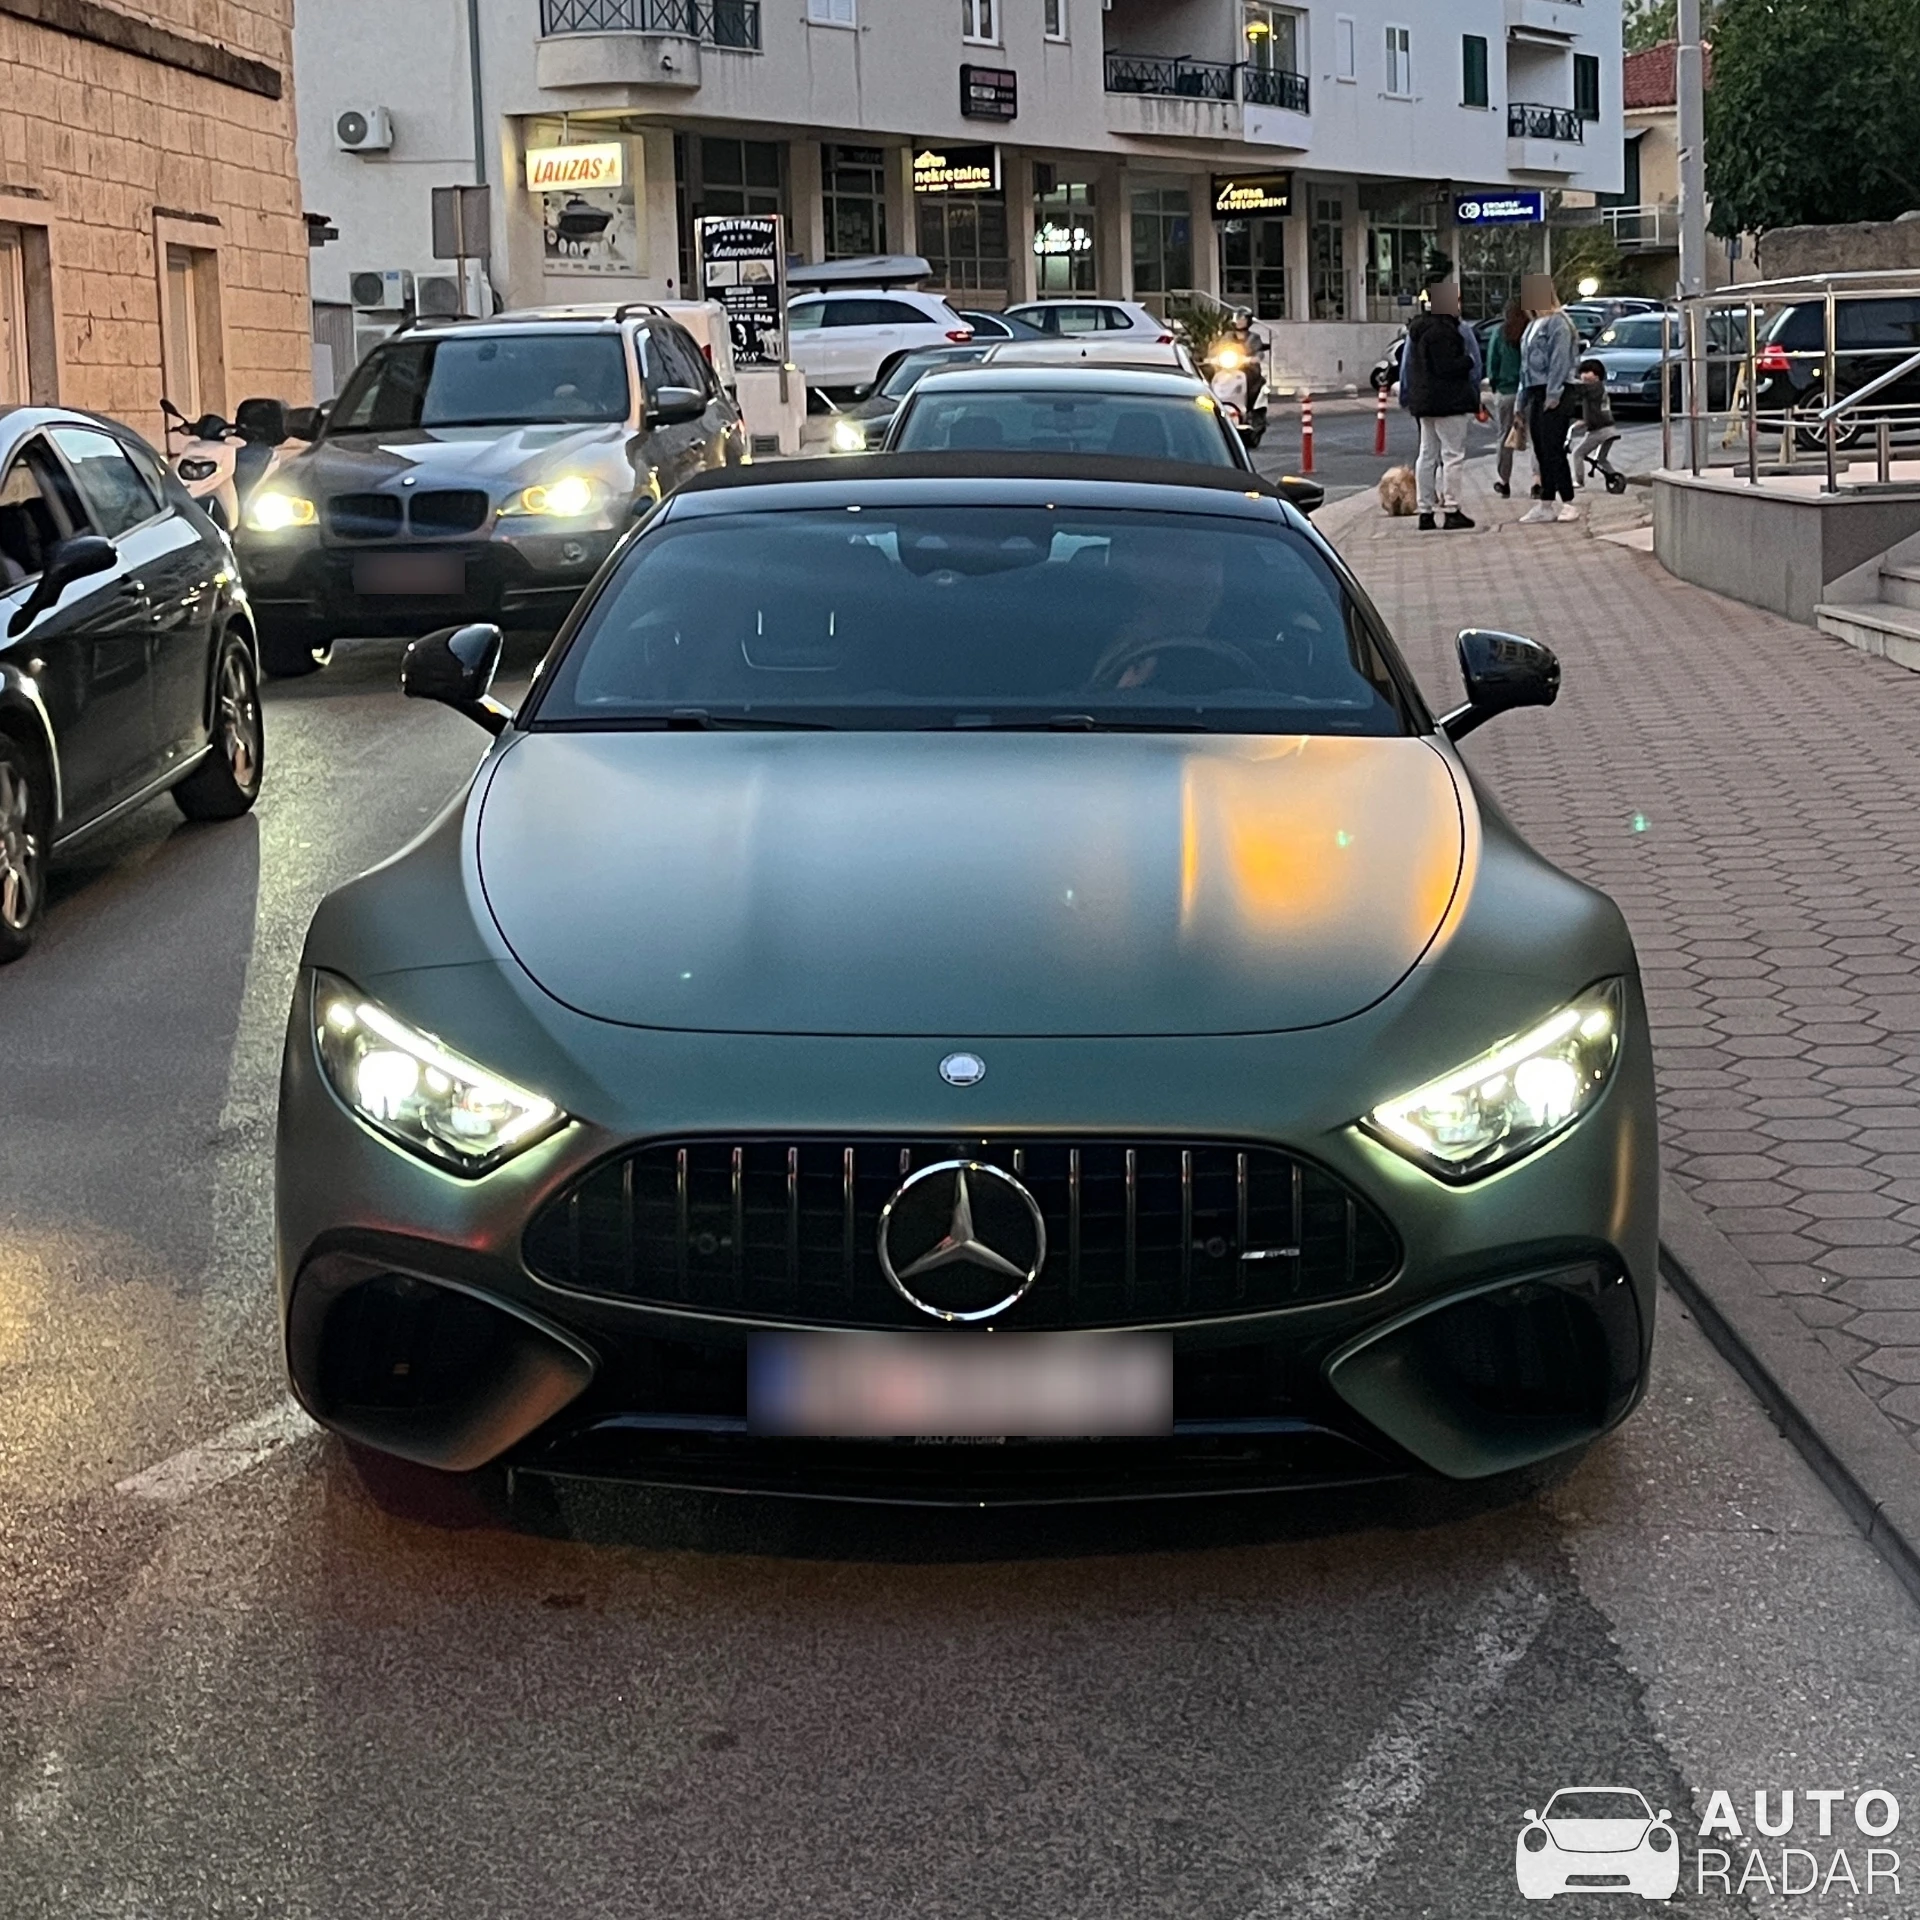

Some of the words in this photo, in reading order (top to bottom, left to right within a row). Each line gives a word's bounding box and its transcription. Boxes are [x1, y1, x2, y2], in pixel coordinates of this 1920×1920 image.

[534, 157, 603, 185] LALIZAS
[914, 165, 990, 183] nekretnine
[1216, 196, 1288, 211] DEVELOPMENT
[705, 219, 773, 237] APARTMANI
